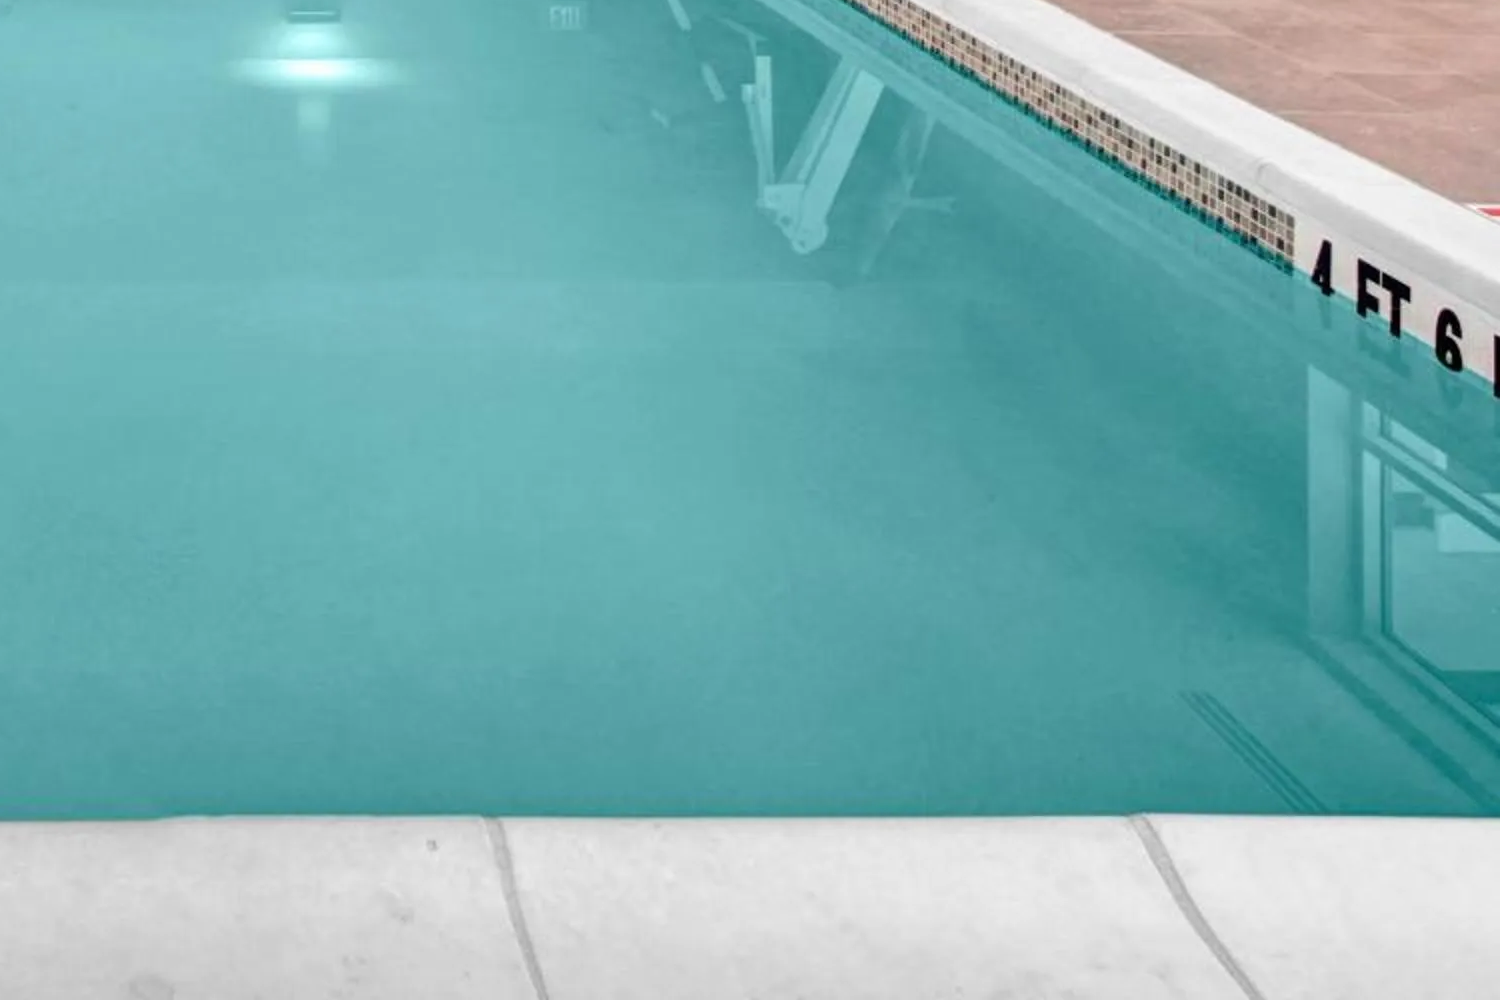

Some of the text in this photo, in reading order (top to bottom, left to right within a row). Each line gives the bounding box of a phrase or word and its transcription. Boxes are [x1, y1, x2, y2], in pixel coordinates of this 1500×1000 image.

[1310, 239, 1335, 297] 4
[1356, 258, 1411, 339] FT
[1435, 307, 1463, 373] 6
